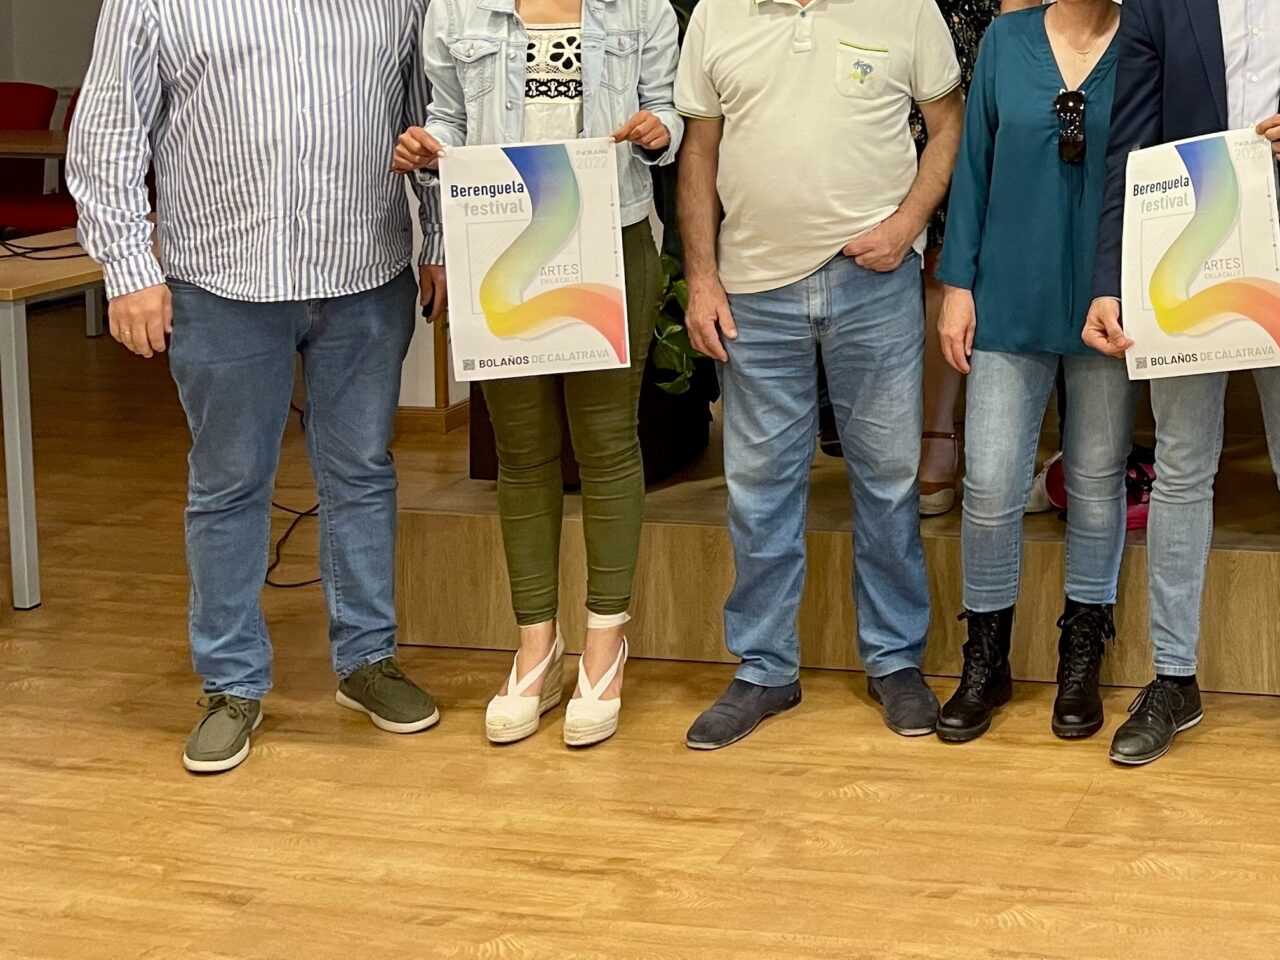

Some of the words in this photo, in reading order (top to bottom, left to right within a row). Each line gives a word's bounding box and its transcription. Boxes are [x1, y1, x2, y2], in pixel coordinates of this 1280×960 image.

[576, 155, 609, 169] 2022
[450, 181, 525, 199] Berenguela
[1133, 175, 1190, 196] Berenguela
[464, 199, 525, 217] festival
[1141, 192, 1189, 213] festival
[539, 263, 579, 278] ARTES
[1204, 258, 1241, 271] ARTES
[479, 354, 530, 369] BOLAÑOS
[531, 353, 546, 364] DE
[547, 348, 610, 364] CALATRAVA
[1150, 352, 1198, 367] BOLAÑOS
[1200, 351, 1213, 362] DE
[1214, 345, 1275, 361] CALATRAVA
